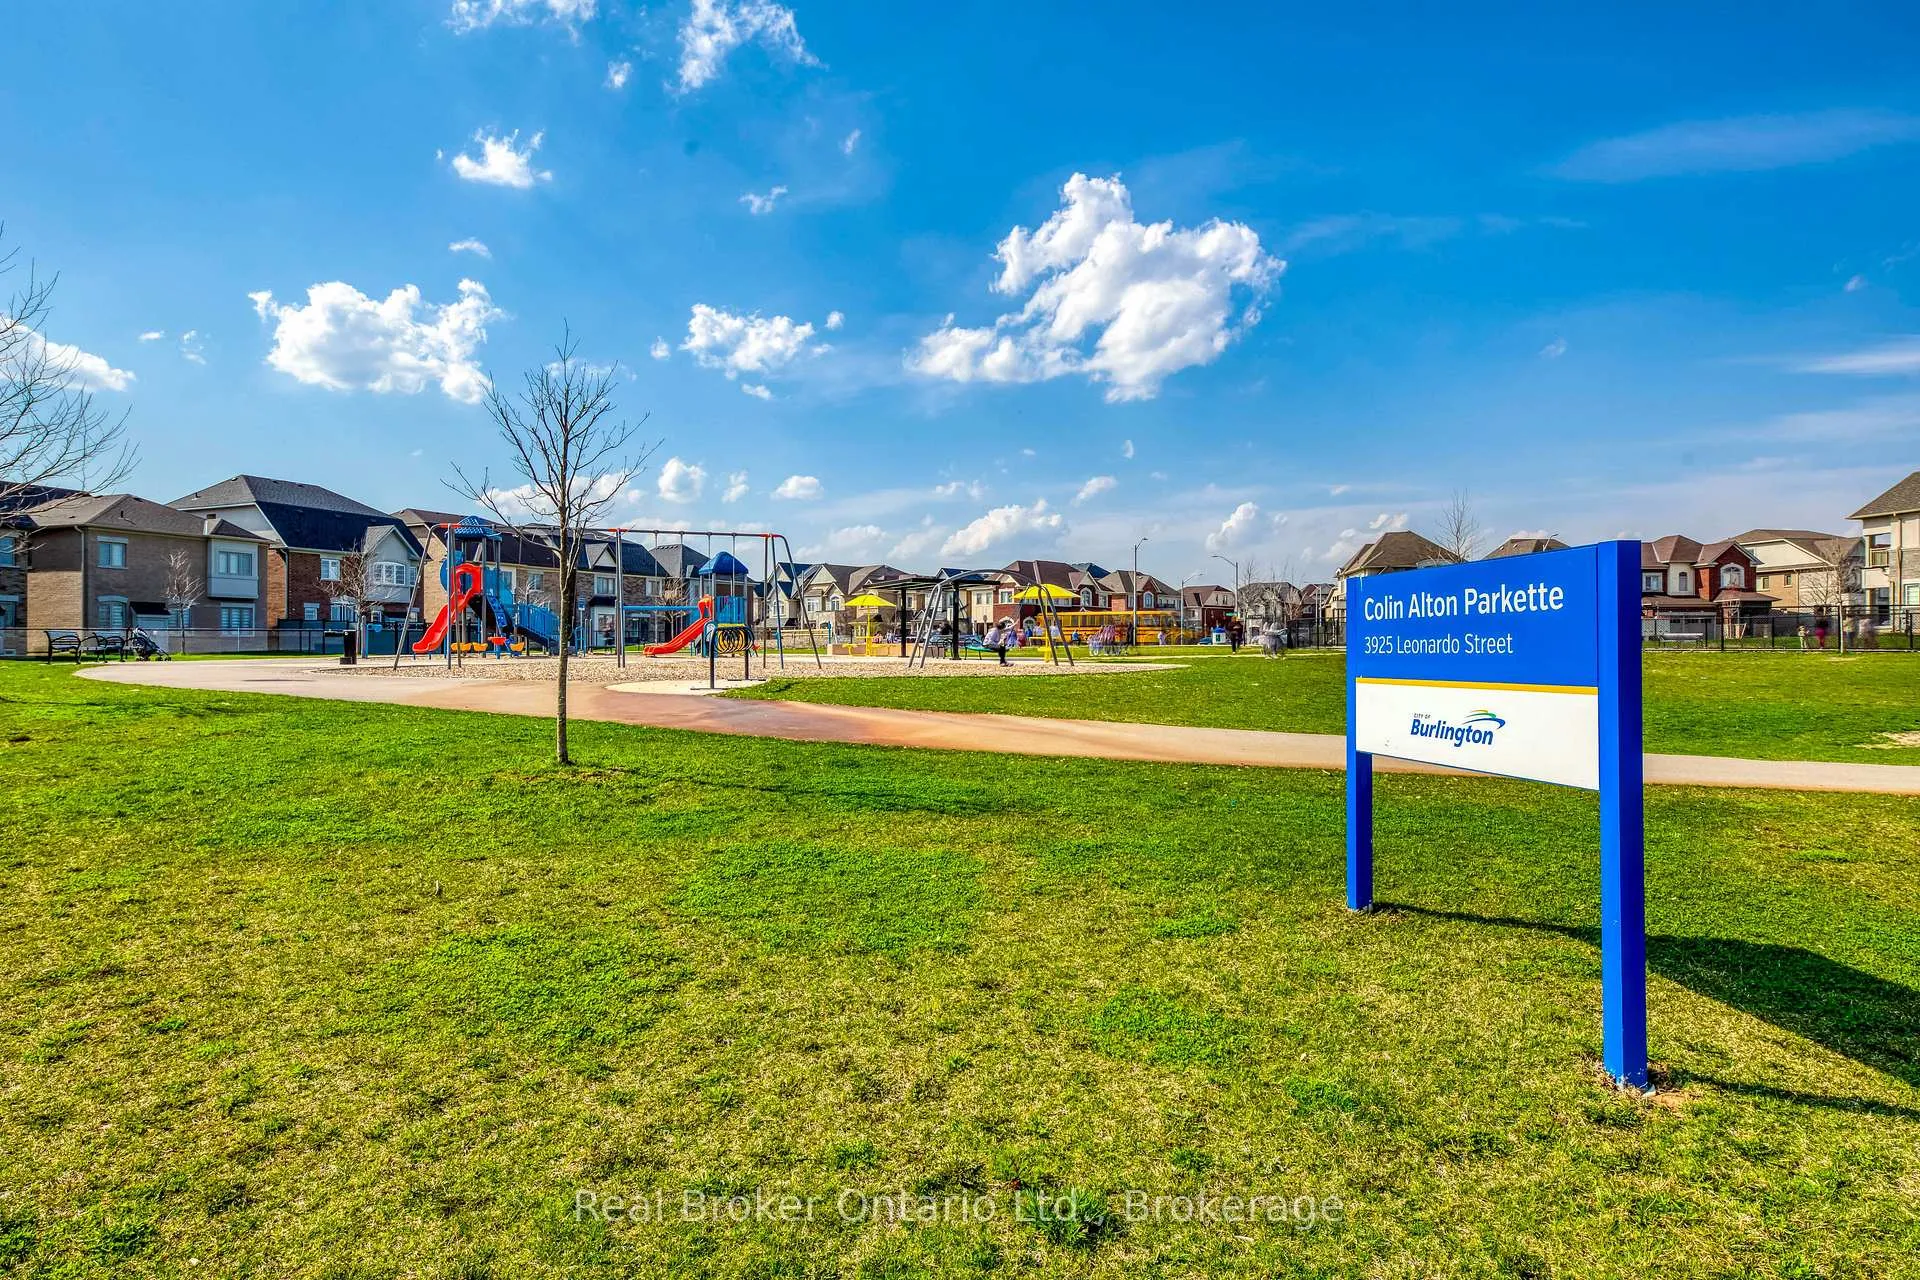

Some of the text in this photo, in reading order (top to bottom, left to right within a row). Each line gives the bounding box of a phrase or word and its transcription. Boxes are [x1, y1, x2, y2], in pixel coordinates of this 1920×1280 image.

[1364, 582, 1564, 621] Colin Alton Parkette
[1364, 633, 1513, 654] 3925 Leonardo Street
[1410, 718, 1494, 747] Burlington
